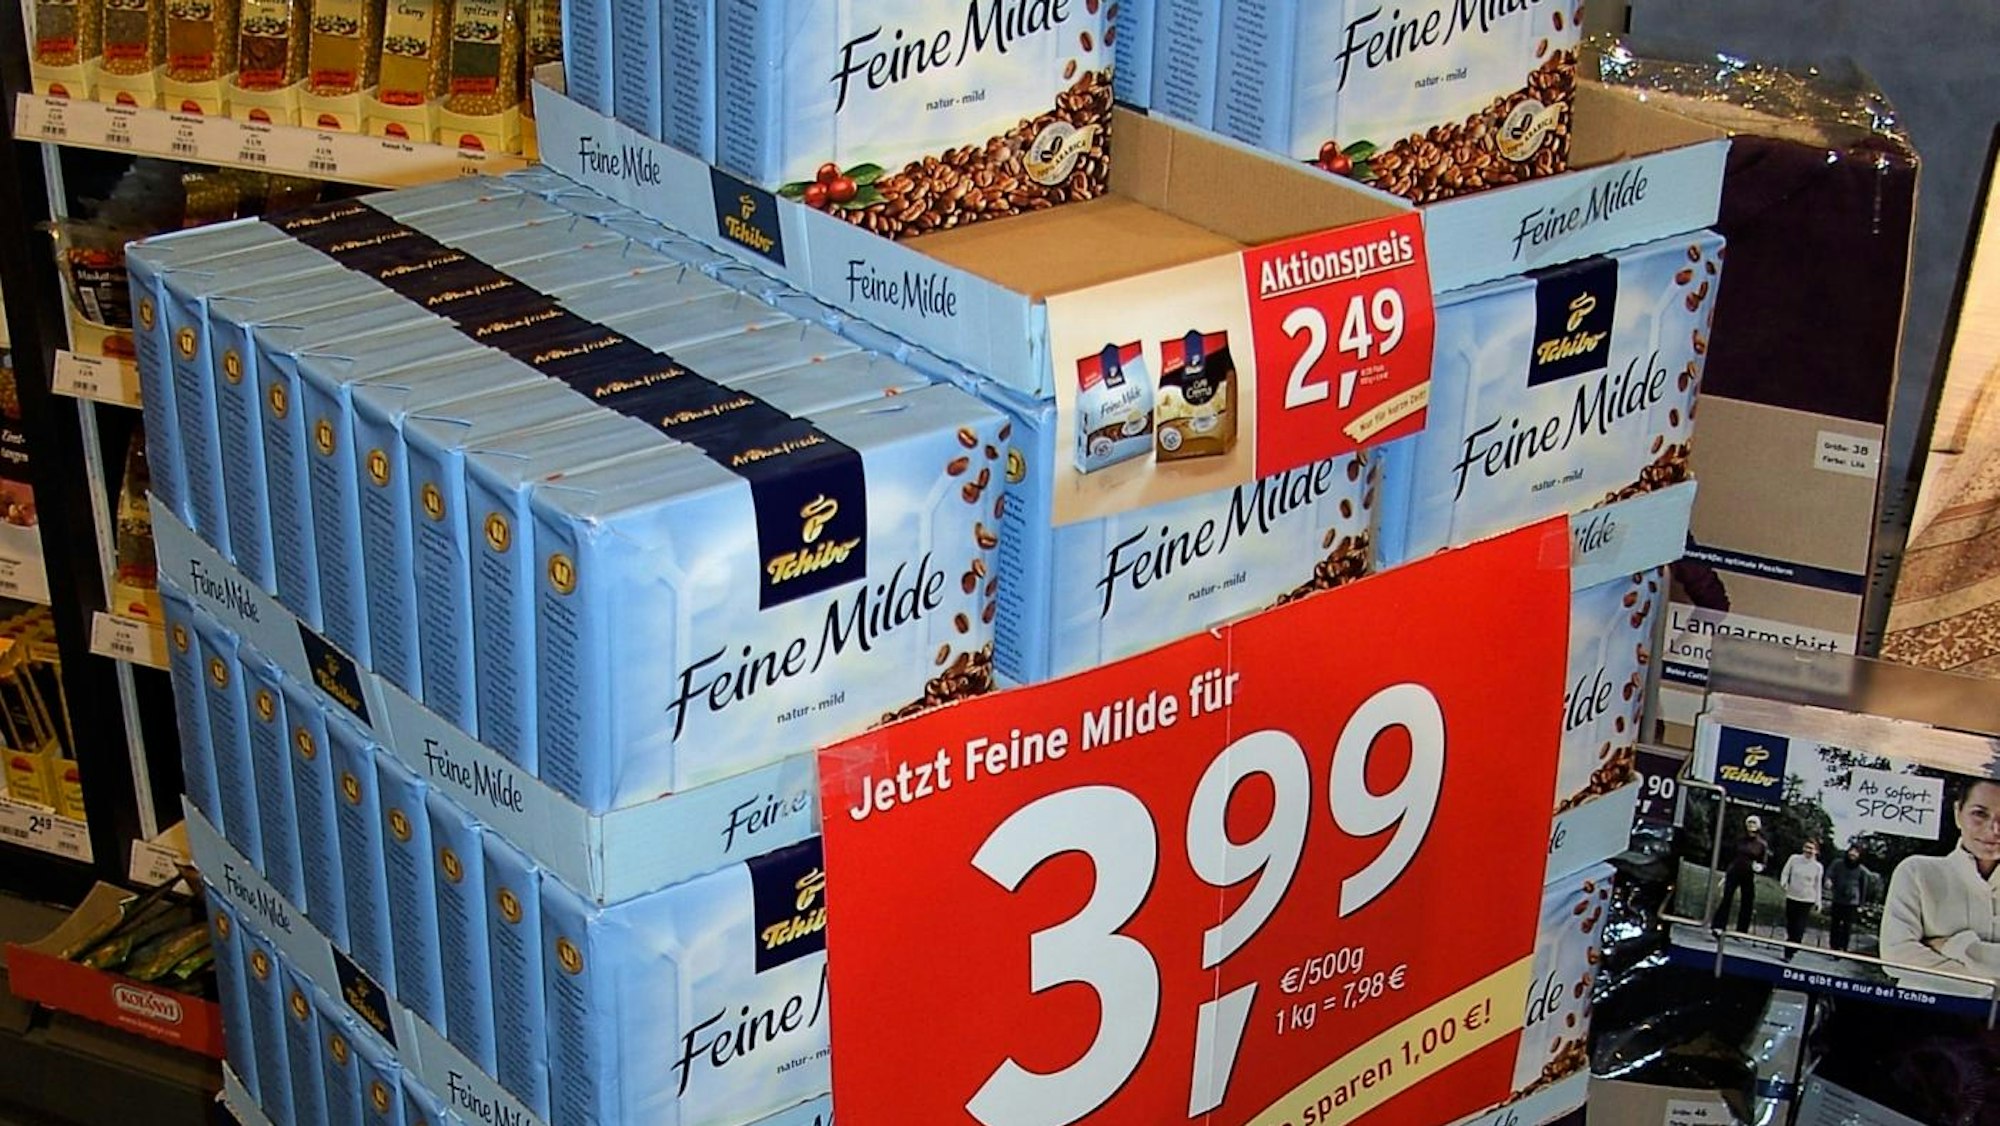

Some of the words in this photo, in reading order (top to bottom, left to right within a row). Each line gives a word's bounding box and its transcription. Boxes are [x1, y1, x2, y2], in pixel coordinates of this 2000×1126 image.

[829, 26, 951, 114] Feine
[1333, 6, 1440, 92] Feine
[926, 97, 955, 112] natur
[962, 89, 986, 105] mild
[1414, 73, 1440, 88] natur
[1446, 68, 1468, 81] mild
[579, 136, 621, 175] Feine
[622, 144, 662, 187] Milde
[724, 215, 774, 253] Tchibo
[1512, 206, 1580, 262] Feine
[1579, 166, 1649, 231] Milde
[846, 259, 899, 306] Feine
[900, 270, 957, 319] Milde
[1260, 230, 1415, 295] Aktionspreis
[1281, 286, 1406, 410] 2,49
[1536, 331, 1608, 366] Tchibo
[1100, 399, 1121, 417] Feine
[1121, 386, 1143, 404] Milde
[1451, 415, 1560, 502] Feine
[1561, 349, 1668, 451] Milde
[1852, 444, 1868, 456] 38
[1530, 477, 1557, 493] natur
[1562, 468, 1584, 484] mild
[1095, 525, 1215, 621] Feine
[1218, 457, 1333, 556] Milde
[1573, 512, 1616, 554] ilde
[766, 537, 861, 586] Tchibo
[1187, 586, 1216, 601] natur
[1222, 571, 1247, 589] mild
[189, 558, 226, 606] Feine
[225, 576, 261, 624] Milde
[665, 644, 806, 744] Feine
[810, 551, 946, 674] Milde
[776, 703, 810, 724] natur
[818, 691, 846, 712] mild
[848, 748, 951, 822] Jetzt
[965, 729, 1070, 782] Feine
[1081, 689, 1178, 752] Milde
[1188, 667, 1241, 718] für
[423, 737, 473, 792] Feine
[473, 758, 525, 814] Milde
[1719, 764, 1780, 788] Tchibo
[1857, 779, 1879, 796] Ab
[721, 789, 808, 854] Feine
[1855, 798, 1936, 826] SPORT
[223, 863, 257, 910] Feine
[256, 887, 292, 935] Milde
[964, 682, 1448, 1126] 3,99
[1279, 946, 1365, 994] €/500g
[1783, 968, 1806, 982] Das
[1808, 974, 1833, 987] gibt
[1834, 980, 1849, 990] es
[1852, 983, 1872, 995] nur
[1875, 986, 1894, 998] bei
[1896, 989, 1937, 1005] Tchibo
[1274, 1008, 1285, 1035] 1
[1291, 1001, 1317, 1031] kg
[1323, 997, 1336, 1011] =
[1343, 971, 1385, 1011] 7,98
[1388, 964, 1408, 990] €
[669, 1005, 802, 1099] Feine
[775, 1056, 807, 1075] natur
[1301, 1057, 1393, 1126] sparen
[1400, 1016, 1457, 1067] 1,00
[1462, 997, 1492, 1031] €!
[447, 1070, 492, 1124] Feine
